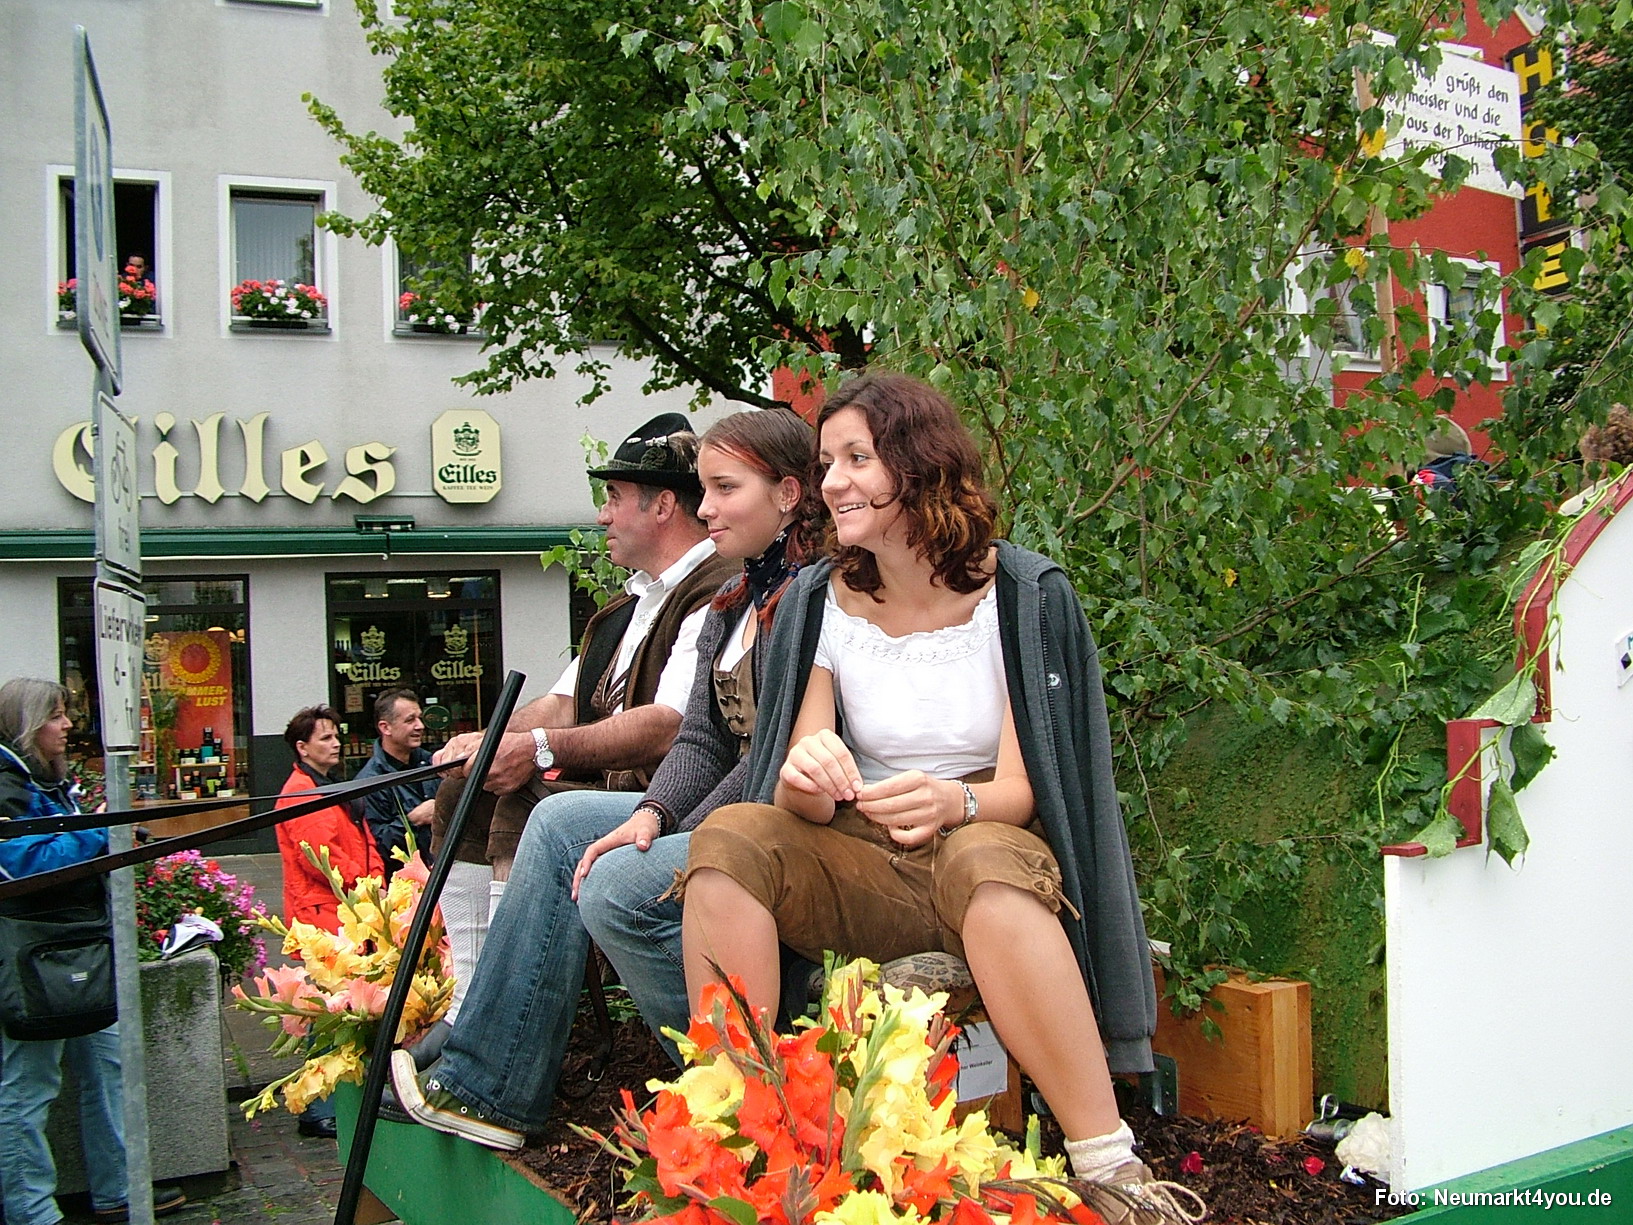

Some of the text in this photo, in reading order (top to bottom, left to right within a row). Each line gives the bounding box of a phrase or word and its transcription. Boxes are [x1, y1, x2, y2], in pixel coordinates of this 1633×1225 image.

[1446, 72, 1481, 97] grüßt
[1488, 85, 1509, 103] den
[1455, 103, 1478, 120] und
[1483, 108, 1501, 126] die
[1406, 117, 1428, 133] aus
[1433, 122, 1451, 140] der
[438, 463, 497, 484] Eilles
[347, 661, 400, 682] Eilles
[431, 660, 484, 679] Eilles
[195, 696, 227, 707] LUST
